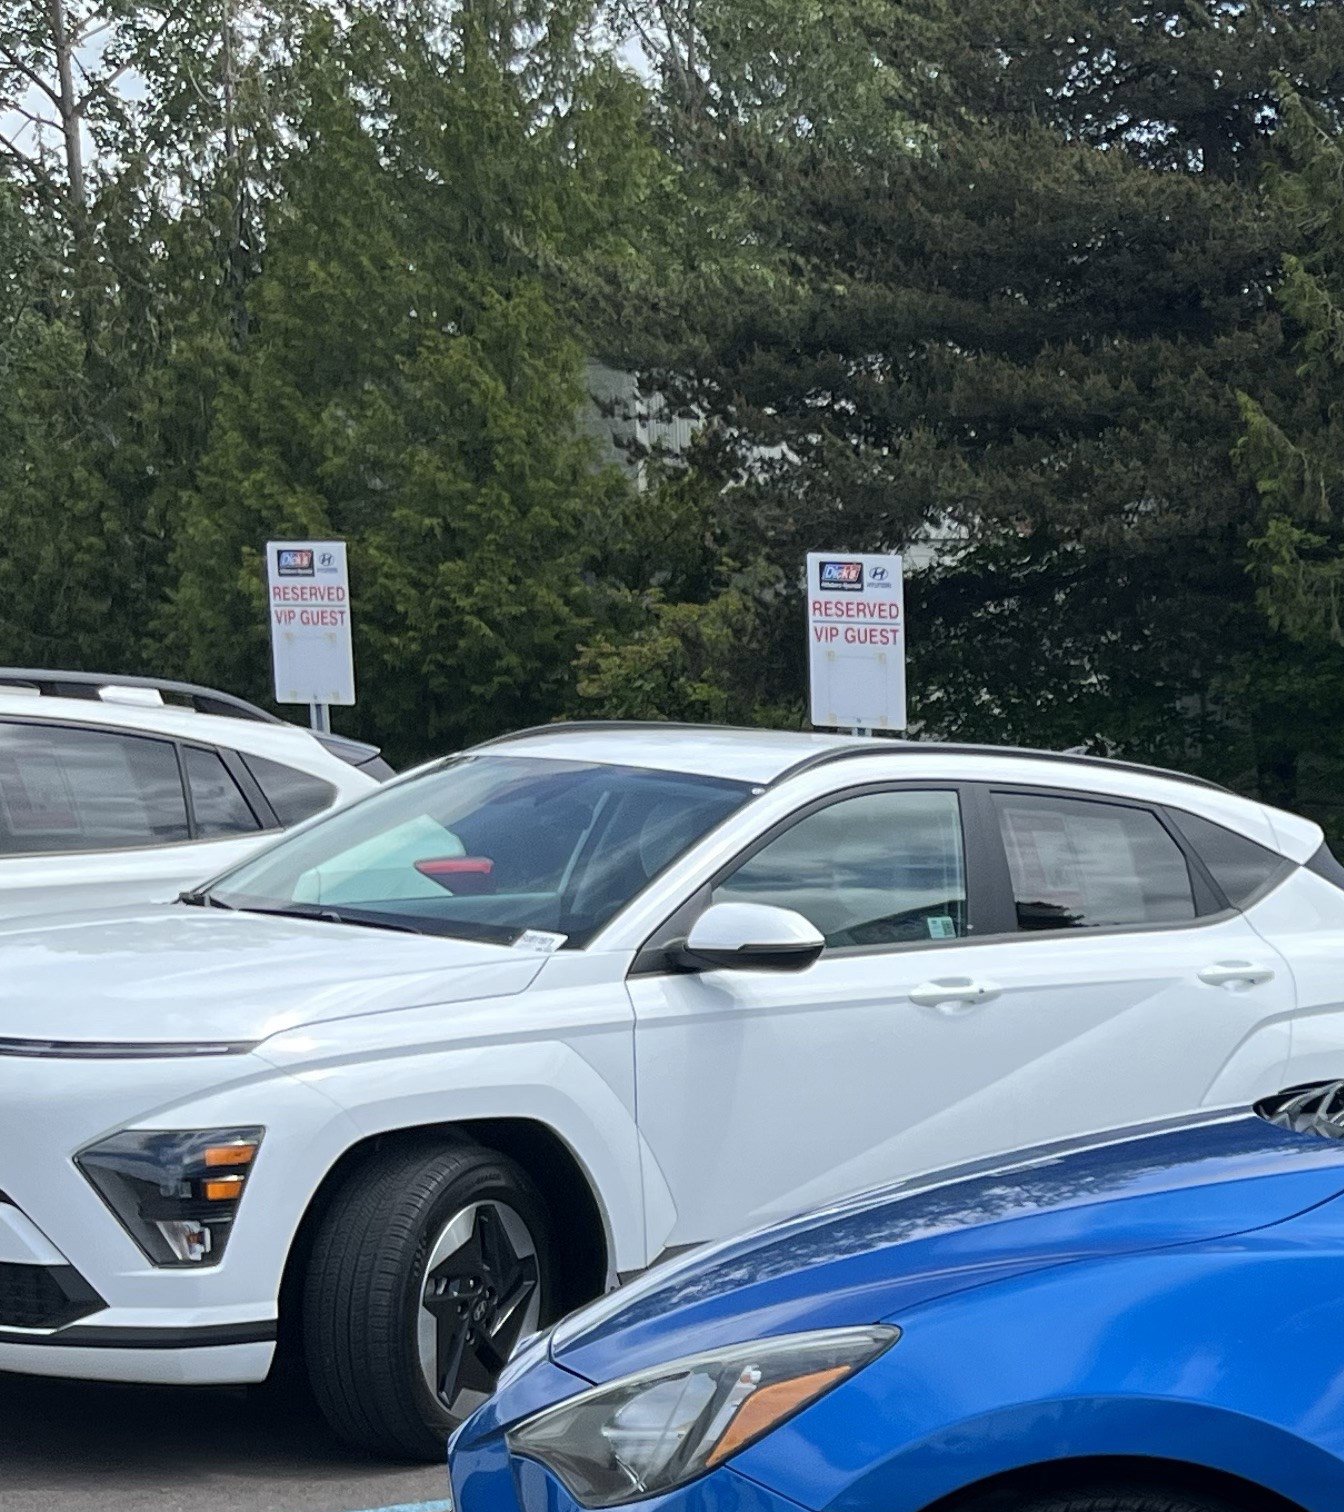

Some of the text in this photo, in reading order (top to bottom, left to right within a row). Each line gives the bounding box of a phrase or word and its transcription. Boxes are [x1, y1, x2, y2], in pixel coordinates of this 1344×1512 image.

[272, 586, 346, 602] RESERVED
[274, 608, 346, 626] VIP GUEST
[812, 601, 899, 619] RESERVED
[814, 626, 899, 645] VIP GUEST
